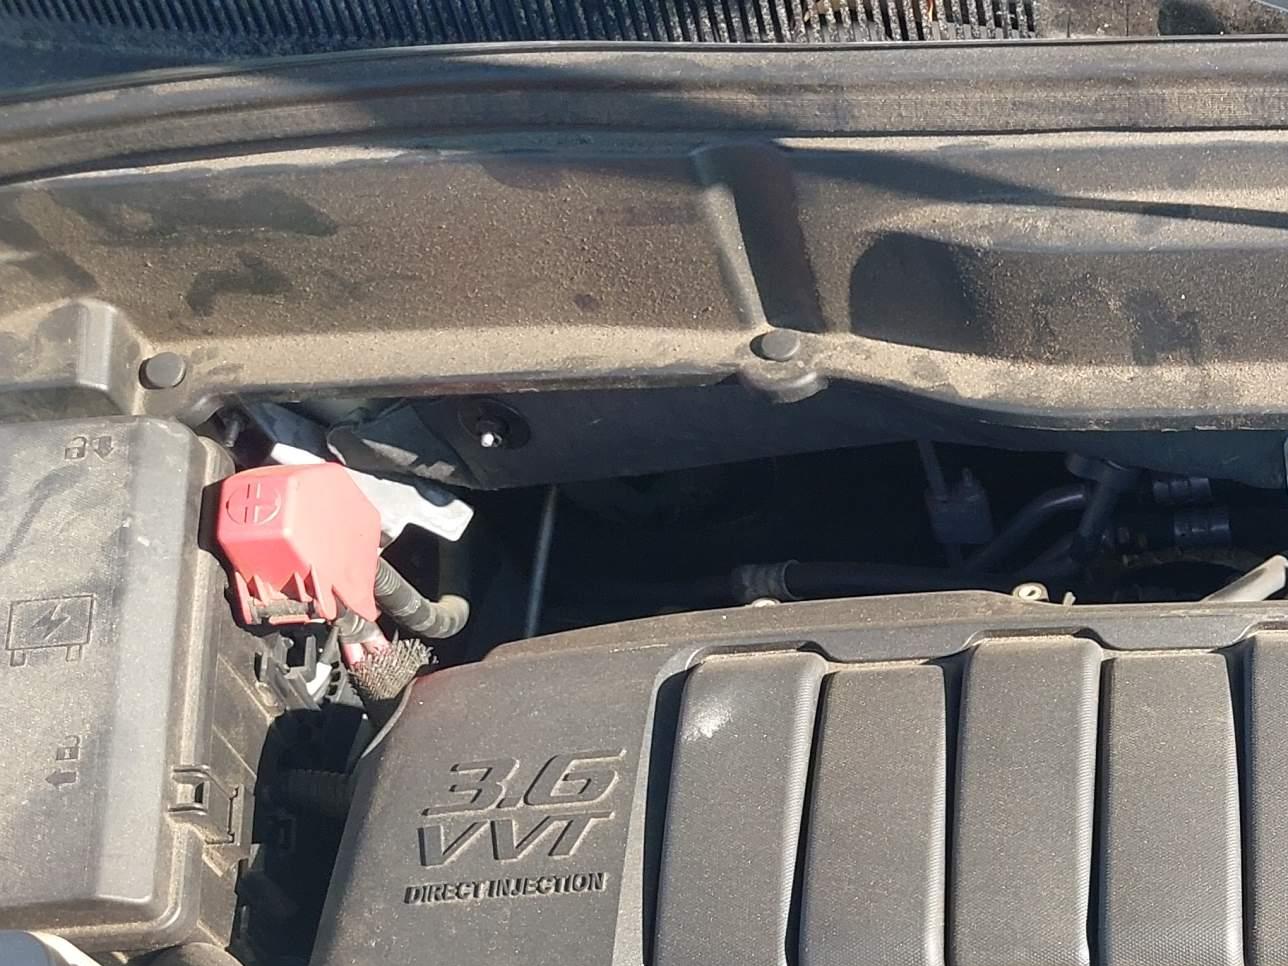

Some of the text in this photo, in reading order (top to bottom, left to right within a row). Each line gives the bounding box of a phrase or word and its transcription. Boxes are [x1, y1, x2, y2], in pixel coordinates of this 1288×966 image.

[421, 748, 627, 817] 3.6
[417, 811, 615, 868] VVT
[403, 872, 608, 905] DIRECT INJECTION
